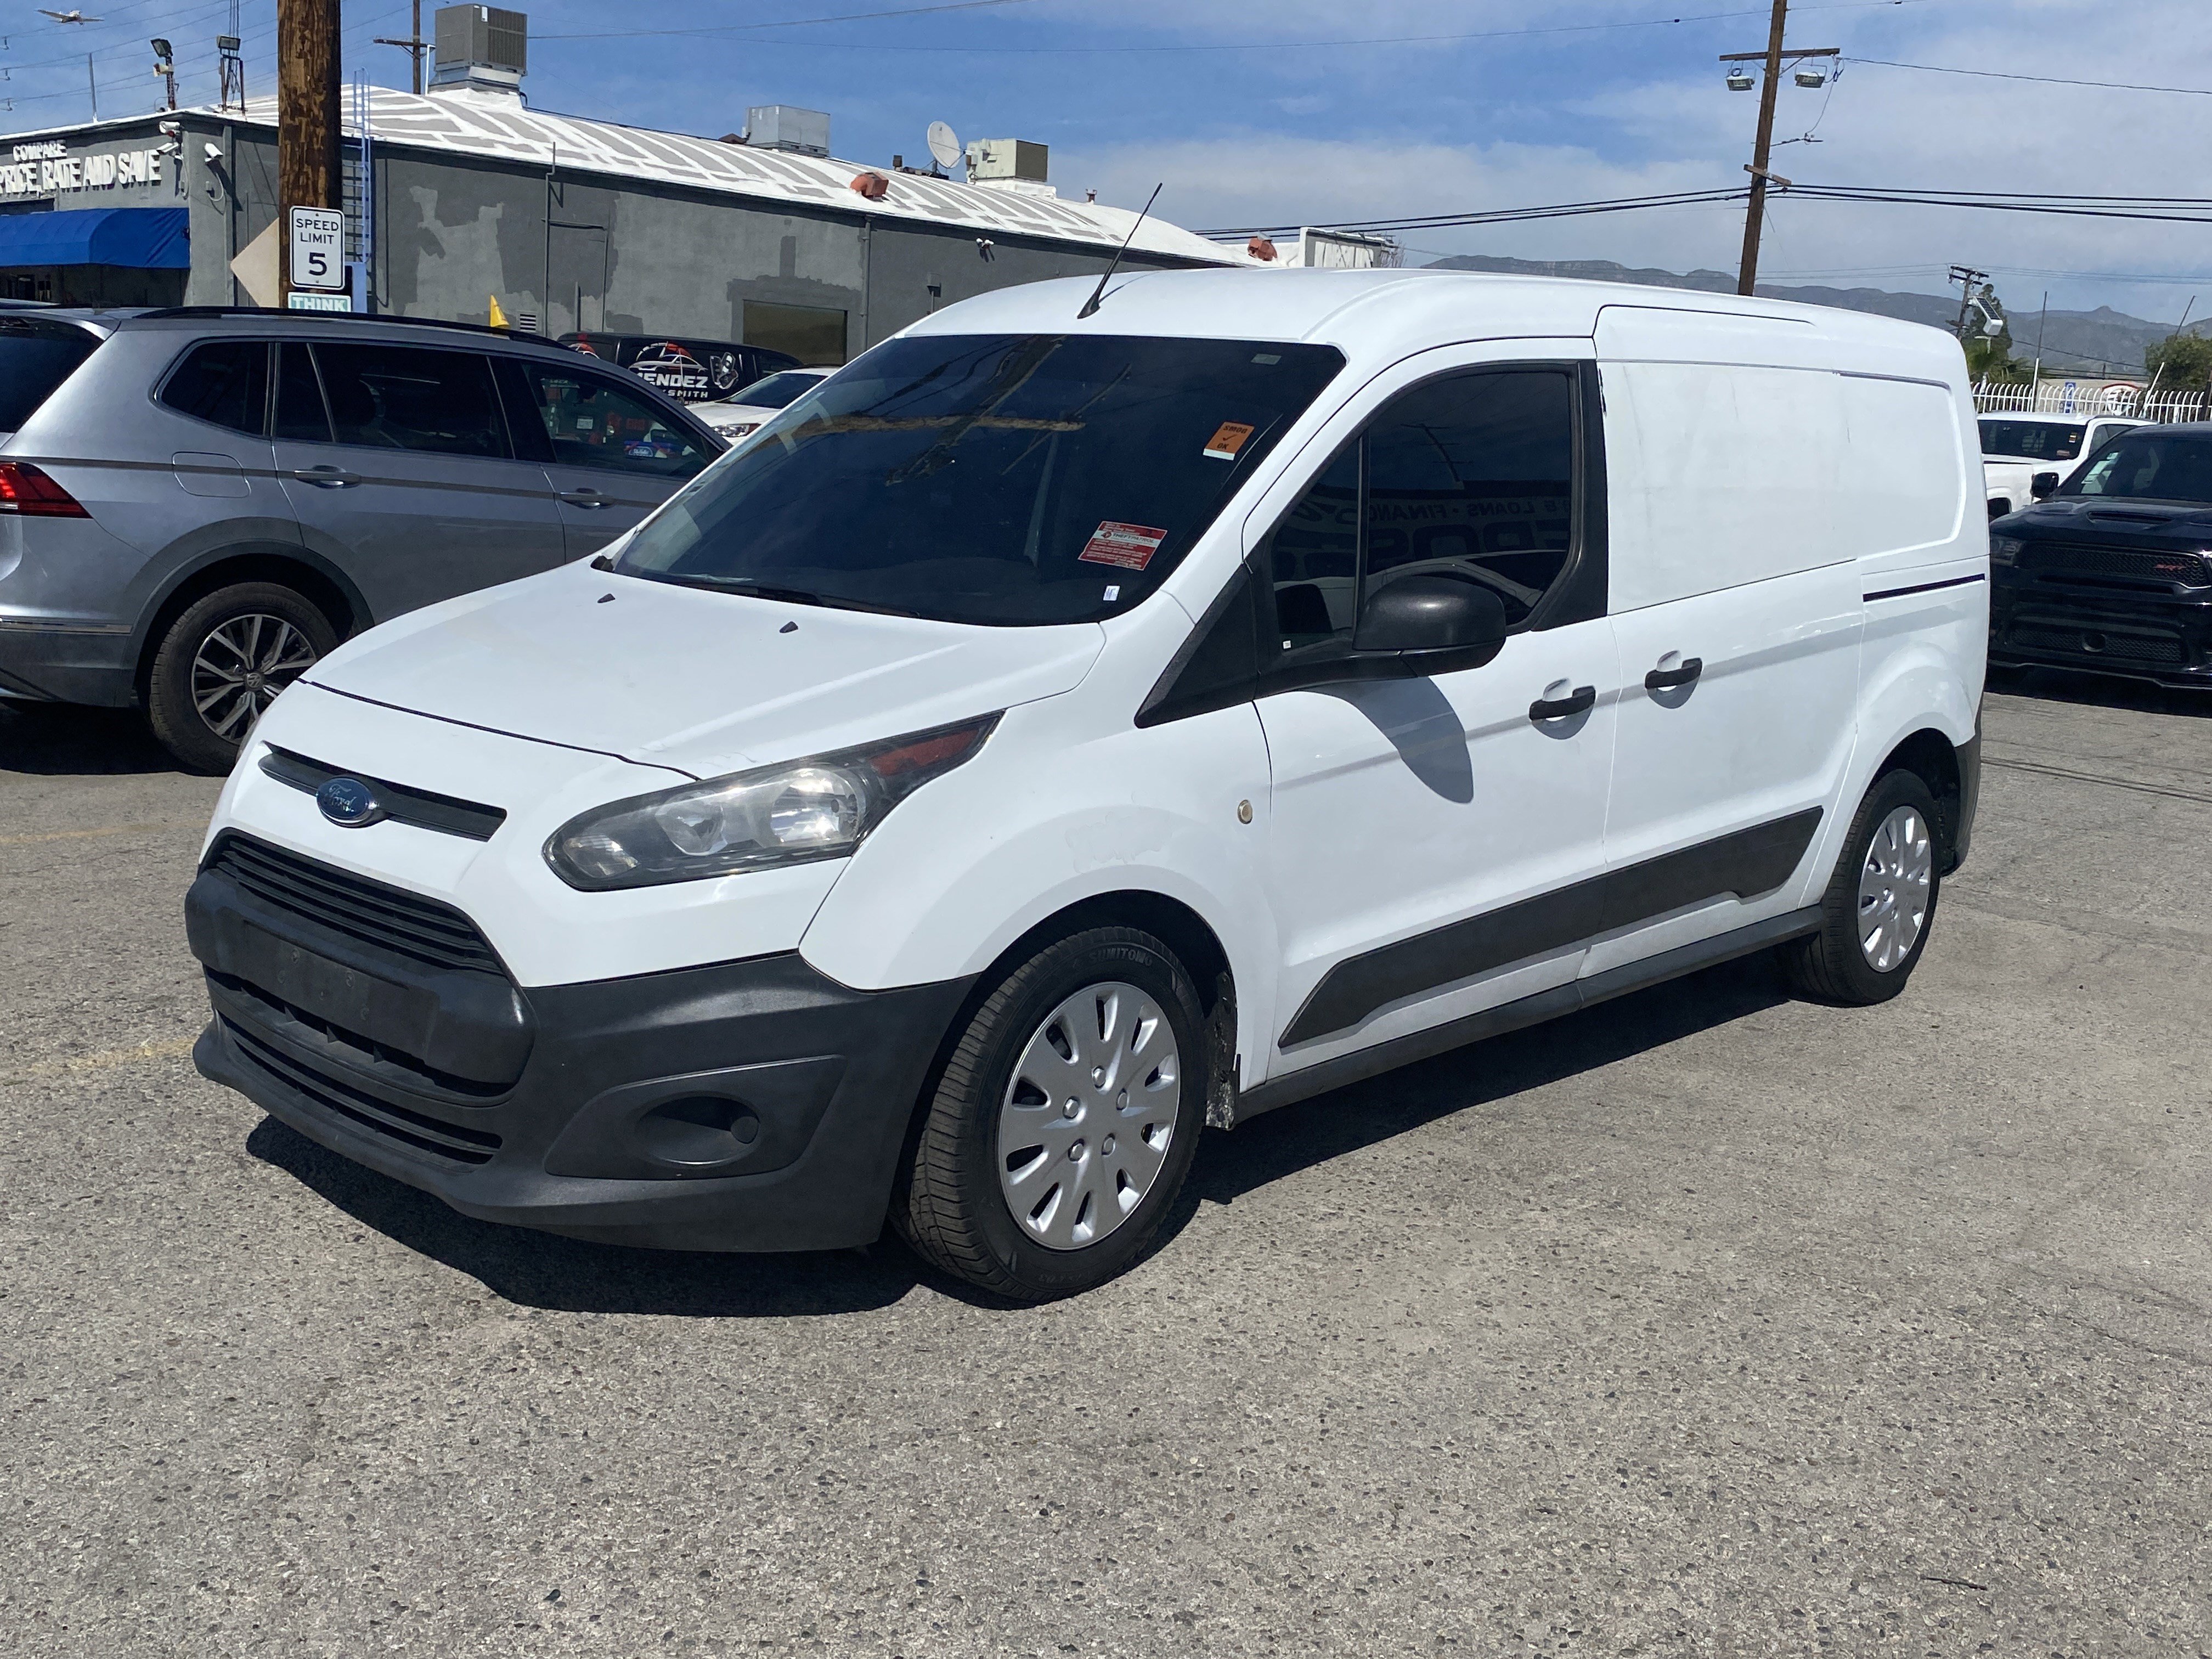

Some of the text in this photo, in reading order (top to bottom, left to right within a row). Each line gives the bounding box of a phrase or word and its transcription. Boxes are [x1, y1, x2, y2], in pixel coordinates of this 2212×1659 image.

[13, 142, 67, 162] COMPARE
[42, 158, 82, 190] RATE
[84, 154, 116, 186] AND
[118, 149, 162, 184] SAVE
[296, 218, 339, 232] SPEED
[300, 232, 335, 245] LIMIT
[308, 252, 327, 276] 5
[292, 296, 346, 312] THINK
[637, 373, 708, 388] ENDEZ
[663, 389, 708, 398] SMITH
